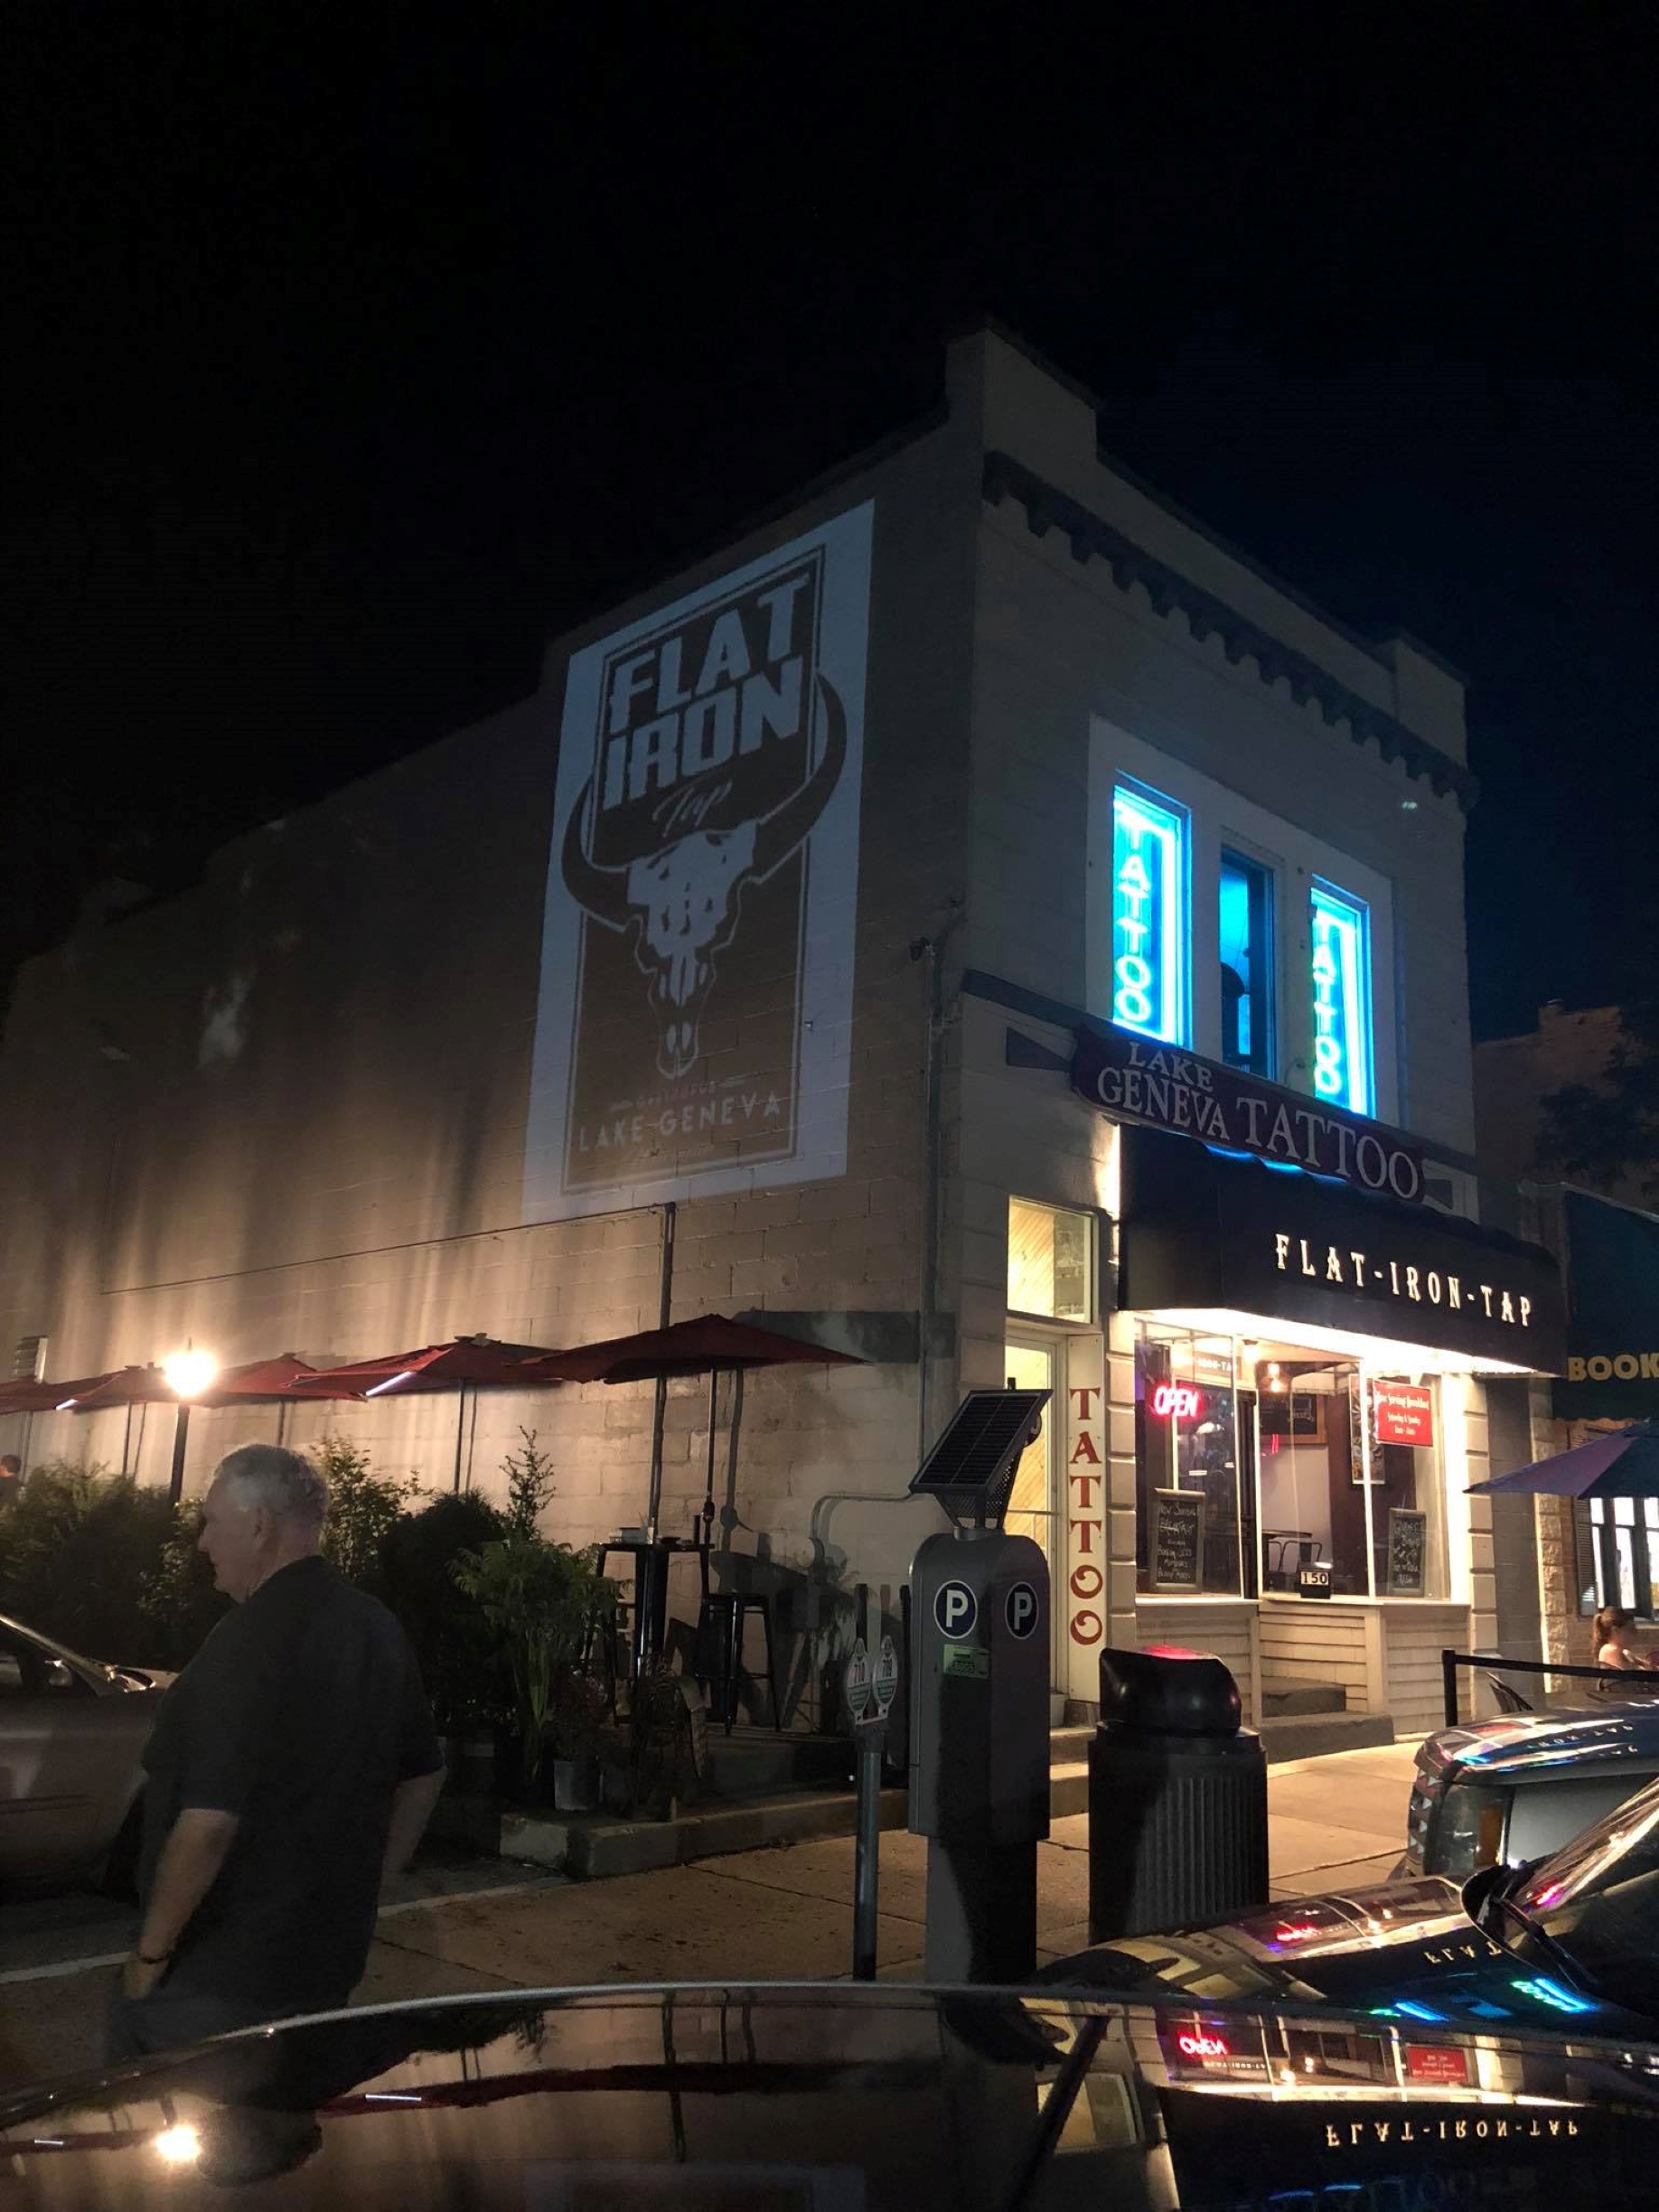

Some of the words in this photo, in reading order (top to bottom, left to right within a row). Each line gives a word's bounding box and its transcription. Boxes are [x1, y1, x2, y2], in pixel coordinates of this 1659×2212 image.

[608, 571, 811, 734] FLAT
[603, 655, 804, 811] IRON
[651, 778, 733, 839] Tap
[1115, 802, 1152, 1023] TATTOO
[1312, 906, 1342, 1094] TATTOO
[1127, 1040, 1214, 1092] LAKE
[577, 1114, 645, 1152] LAKE
[659, 1090, 782, 1138] GENEVA
[1097, 1066, 1230, 1141] GENEVA
[1236, 1096, 1419, 1200] TATTOO
[1275, 1233, 1532, 1326] FLAT-IRON-TAP
[1155, 1386, 1198, 1418] OPEN
[1069, 1387, 1103, 1645] TATTOO
[945, 1589, 969, 1628] P
[1013, 1590, 1032, 1631] P
